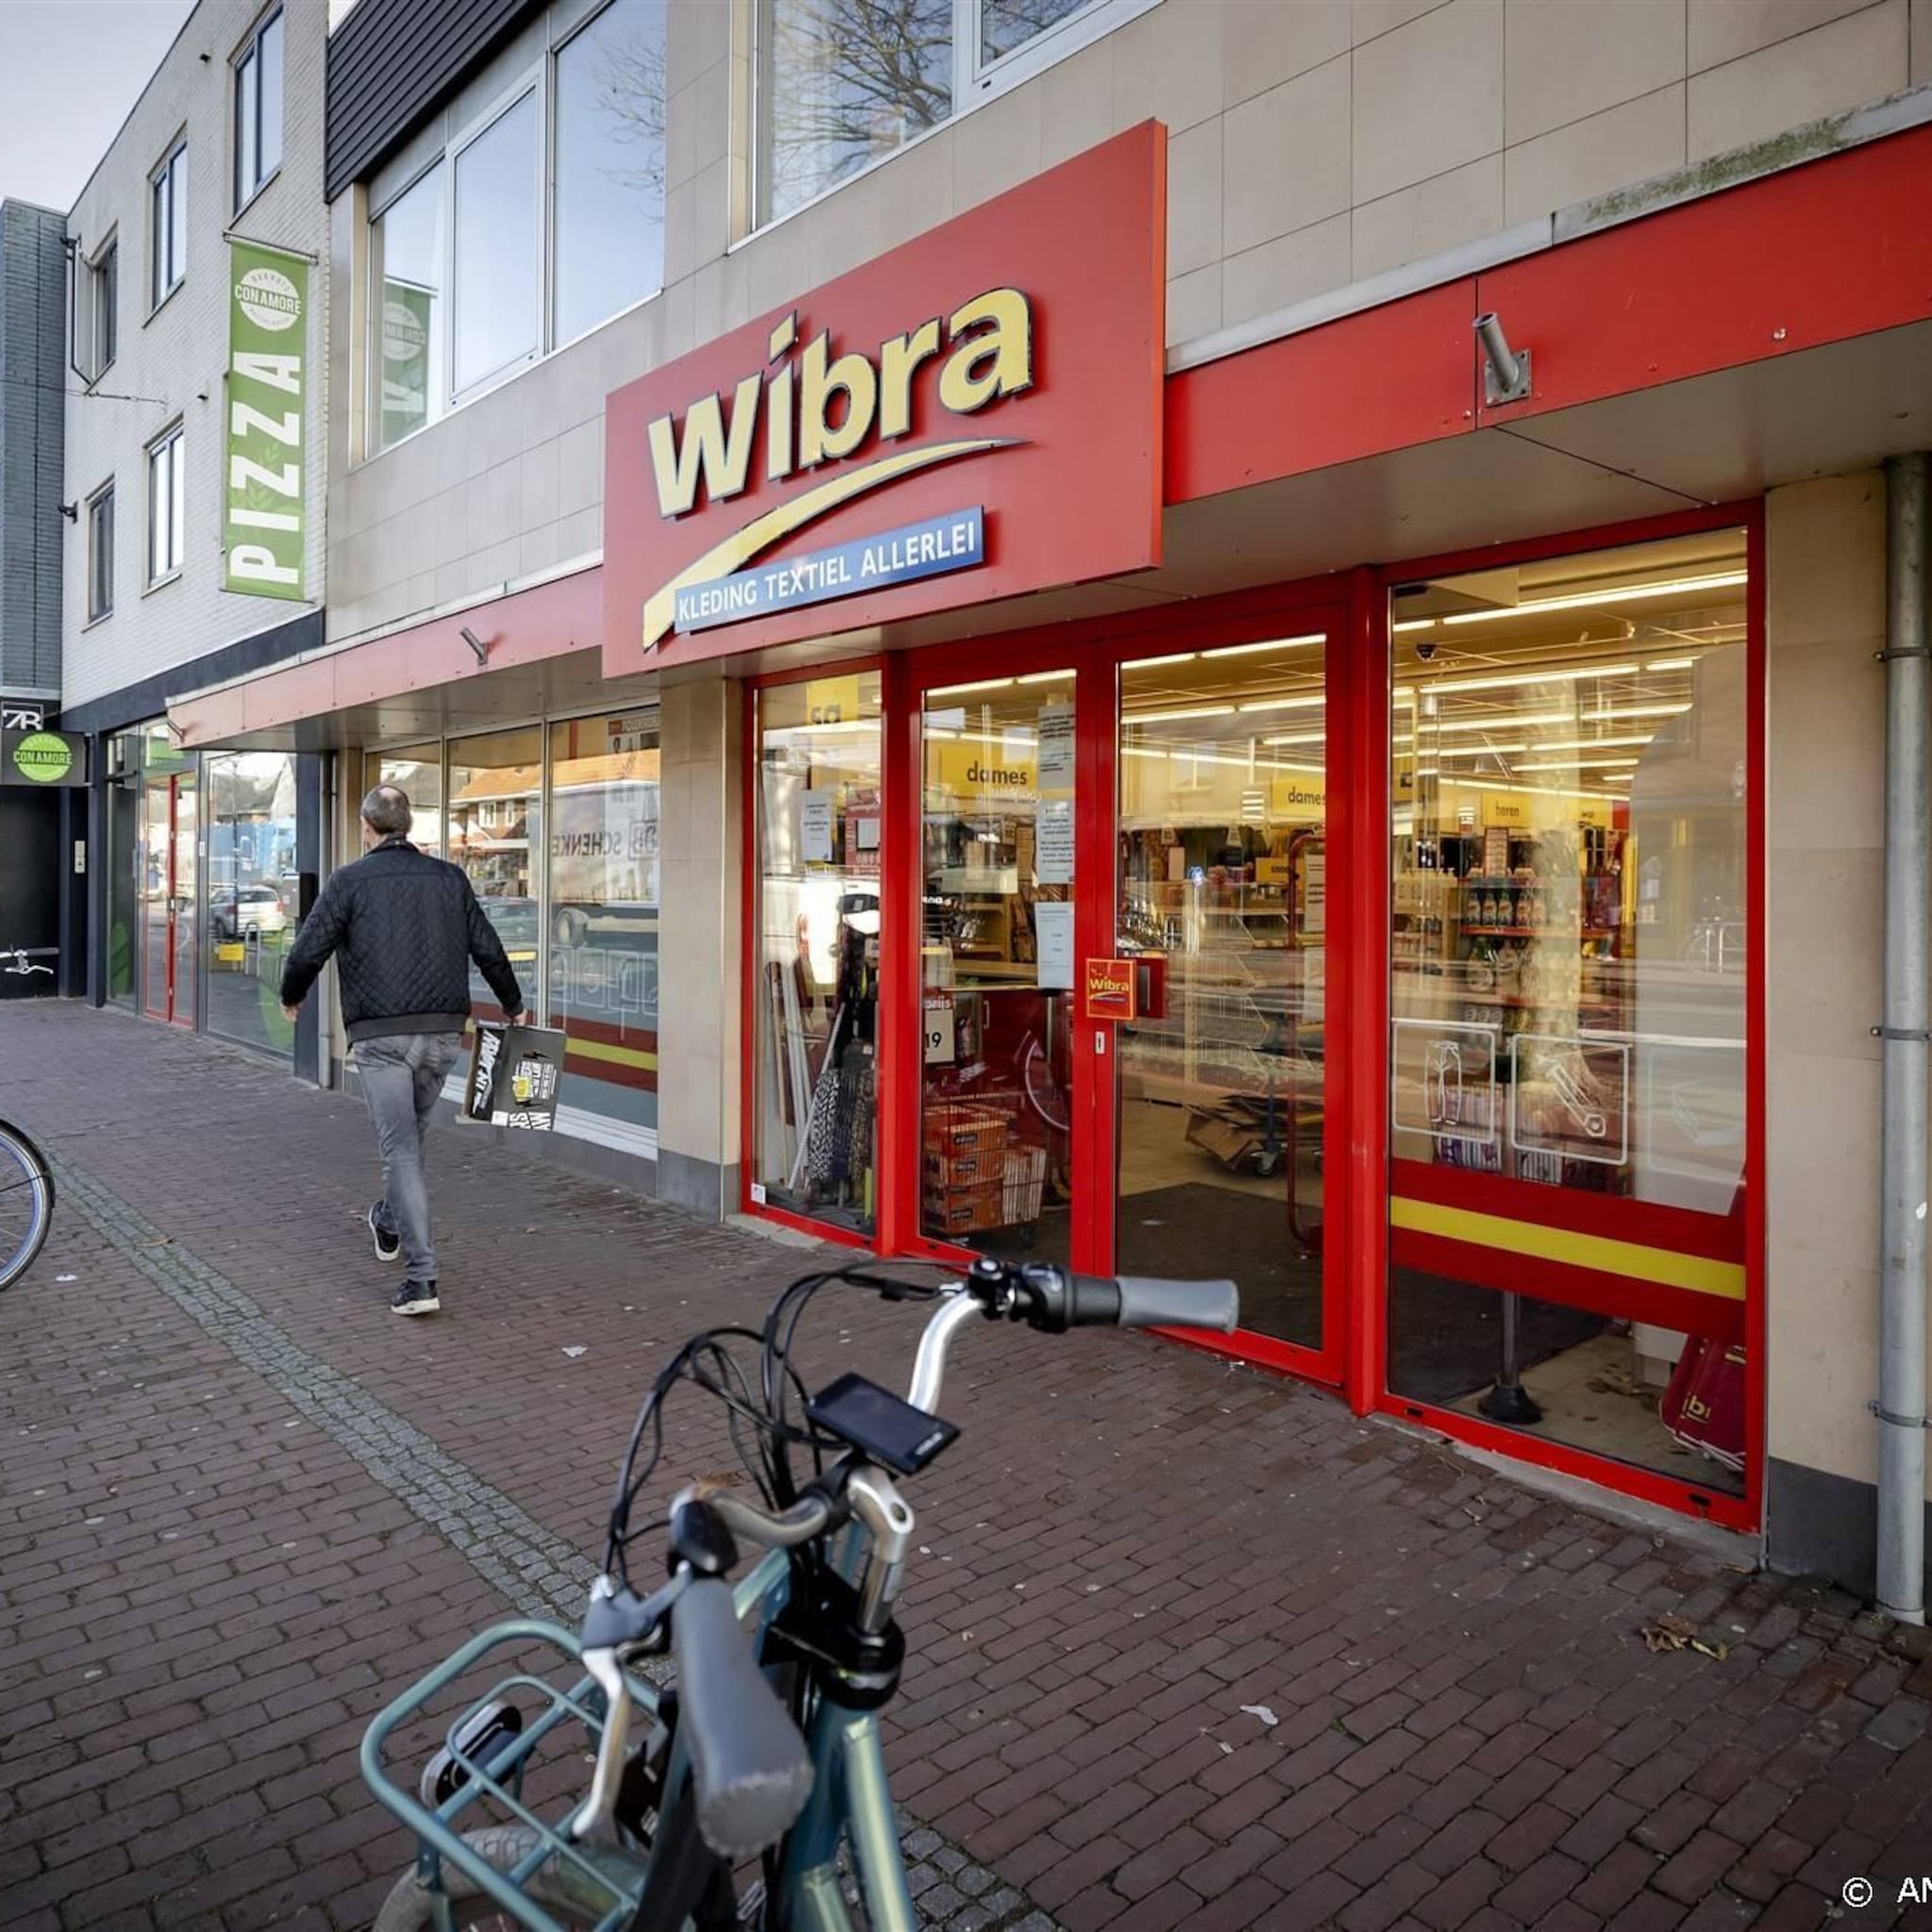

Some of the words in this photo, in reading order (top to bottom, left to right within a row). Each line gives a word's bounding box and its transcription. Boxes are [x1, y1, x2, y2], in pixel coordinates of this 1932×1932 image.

[648, 287, 1033, 519] Wibra
[229, 351, 301, 585] PIZZA
[678, 580, 758, 623] KLEDING
[765, 555, 852, 601] TEXTIEL
[860, 521, 975, 578] ALLERLEI
[966, 759, 1028, 785] dames
[1089, 976, 1130, 991] Wibra
